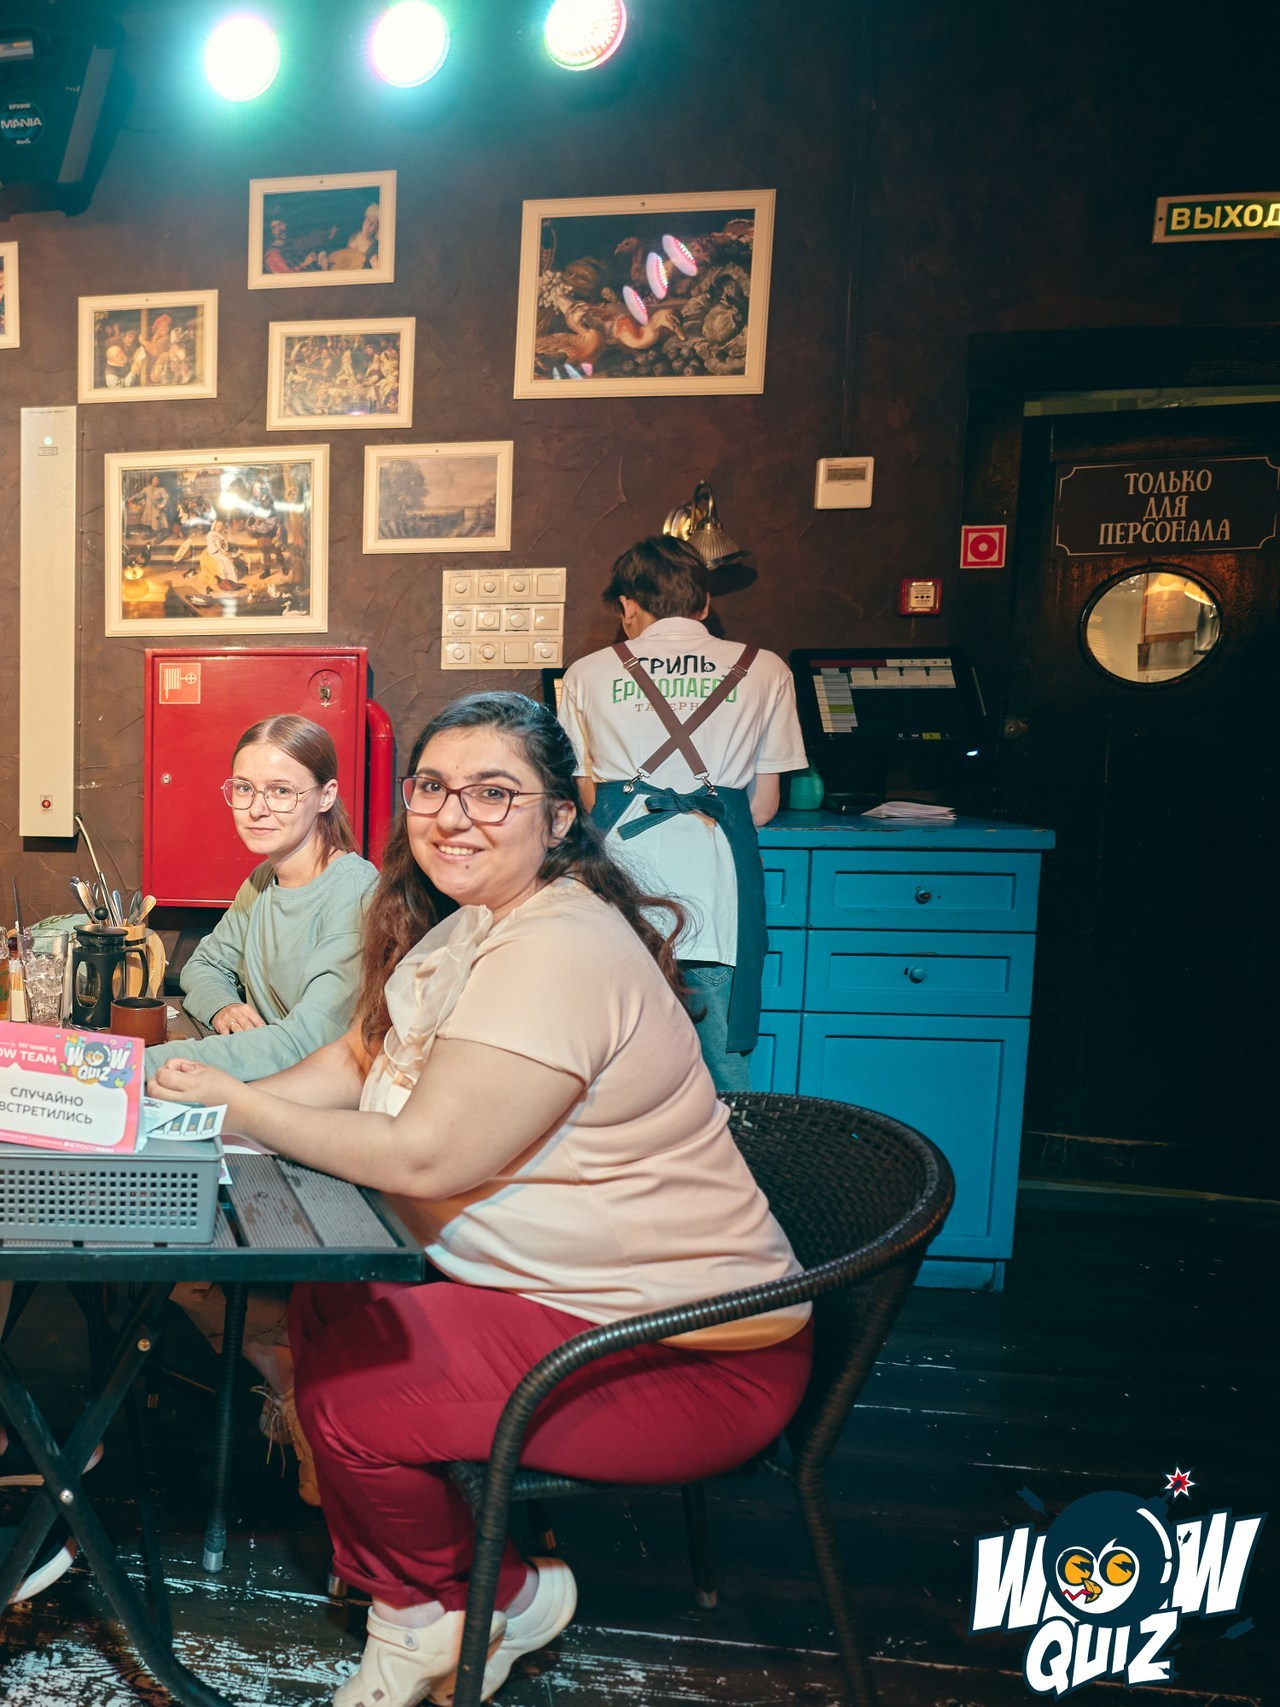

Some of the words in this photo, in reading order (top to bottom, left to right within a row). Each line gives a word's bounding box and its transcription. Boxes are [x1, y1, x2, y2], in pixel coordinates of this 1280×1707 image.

[0, 117, 42, 129] MANIA
[1170, 203, 1280, 231] ВЫХОД
[1124, 469, 1213, 495] ТОЛЬКО
[1143, 495, 1189, 522] ДЛЯ
[1098, 518, 1231, 545] ПЕРСОНАЛА
[635, 702, 701, 712] ТАЕРН
[20, 1050, 57, 1065] TEAM
[66, 1042, 131, 1070] WOW
[77, 1065, 112, 1082] QUIZ
[10, 1086, 84, 1107] СЛУЧАЙНО
